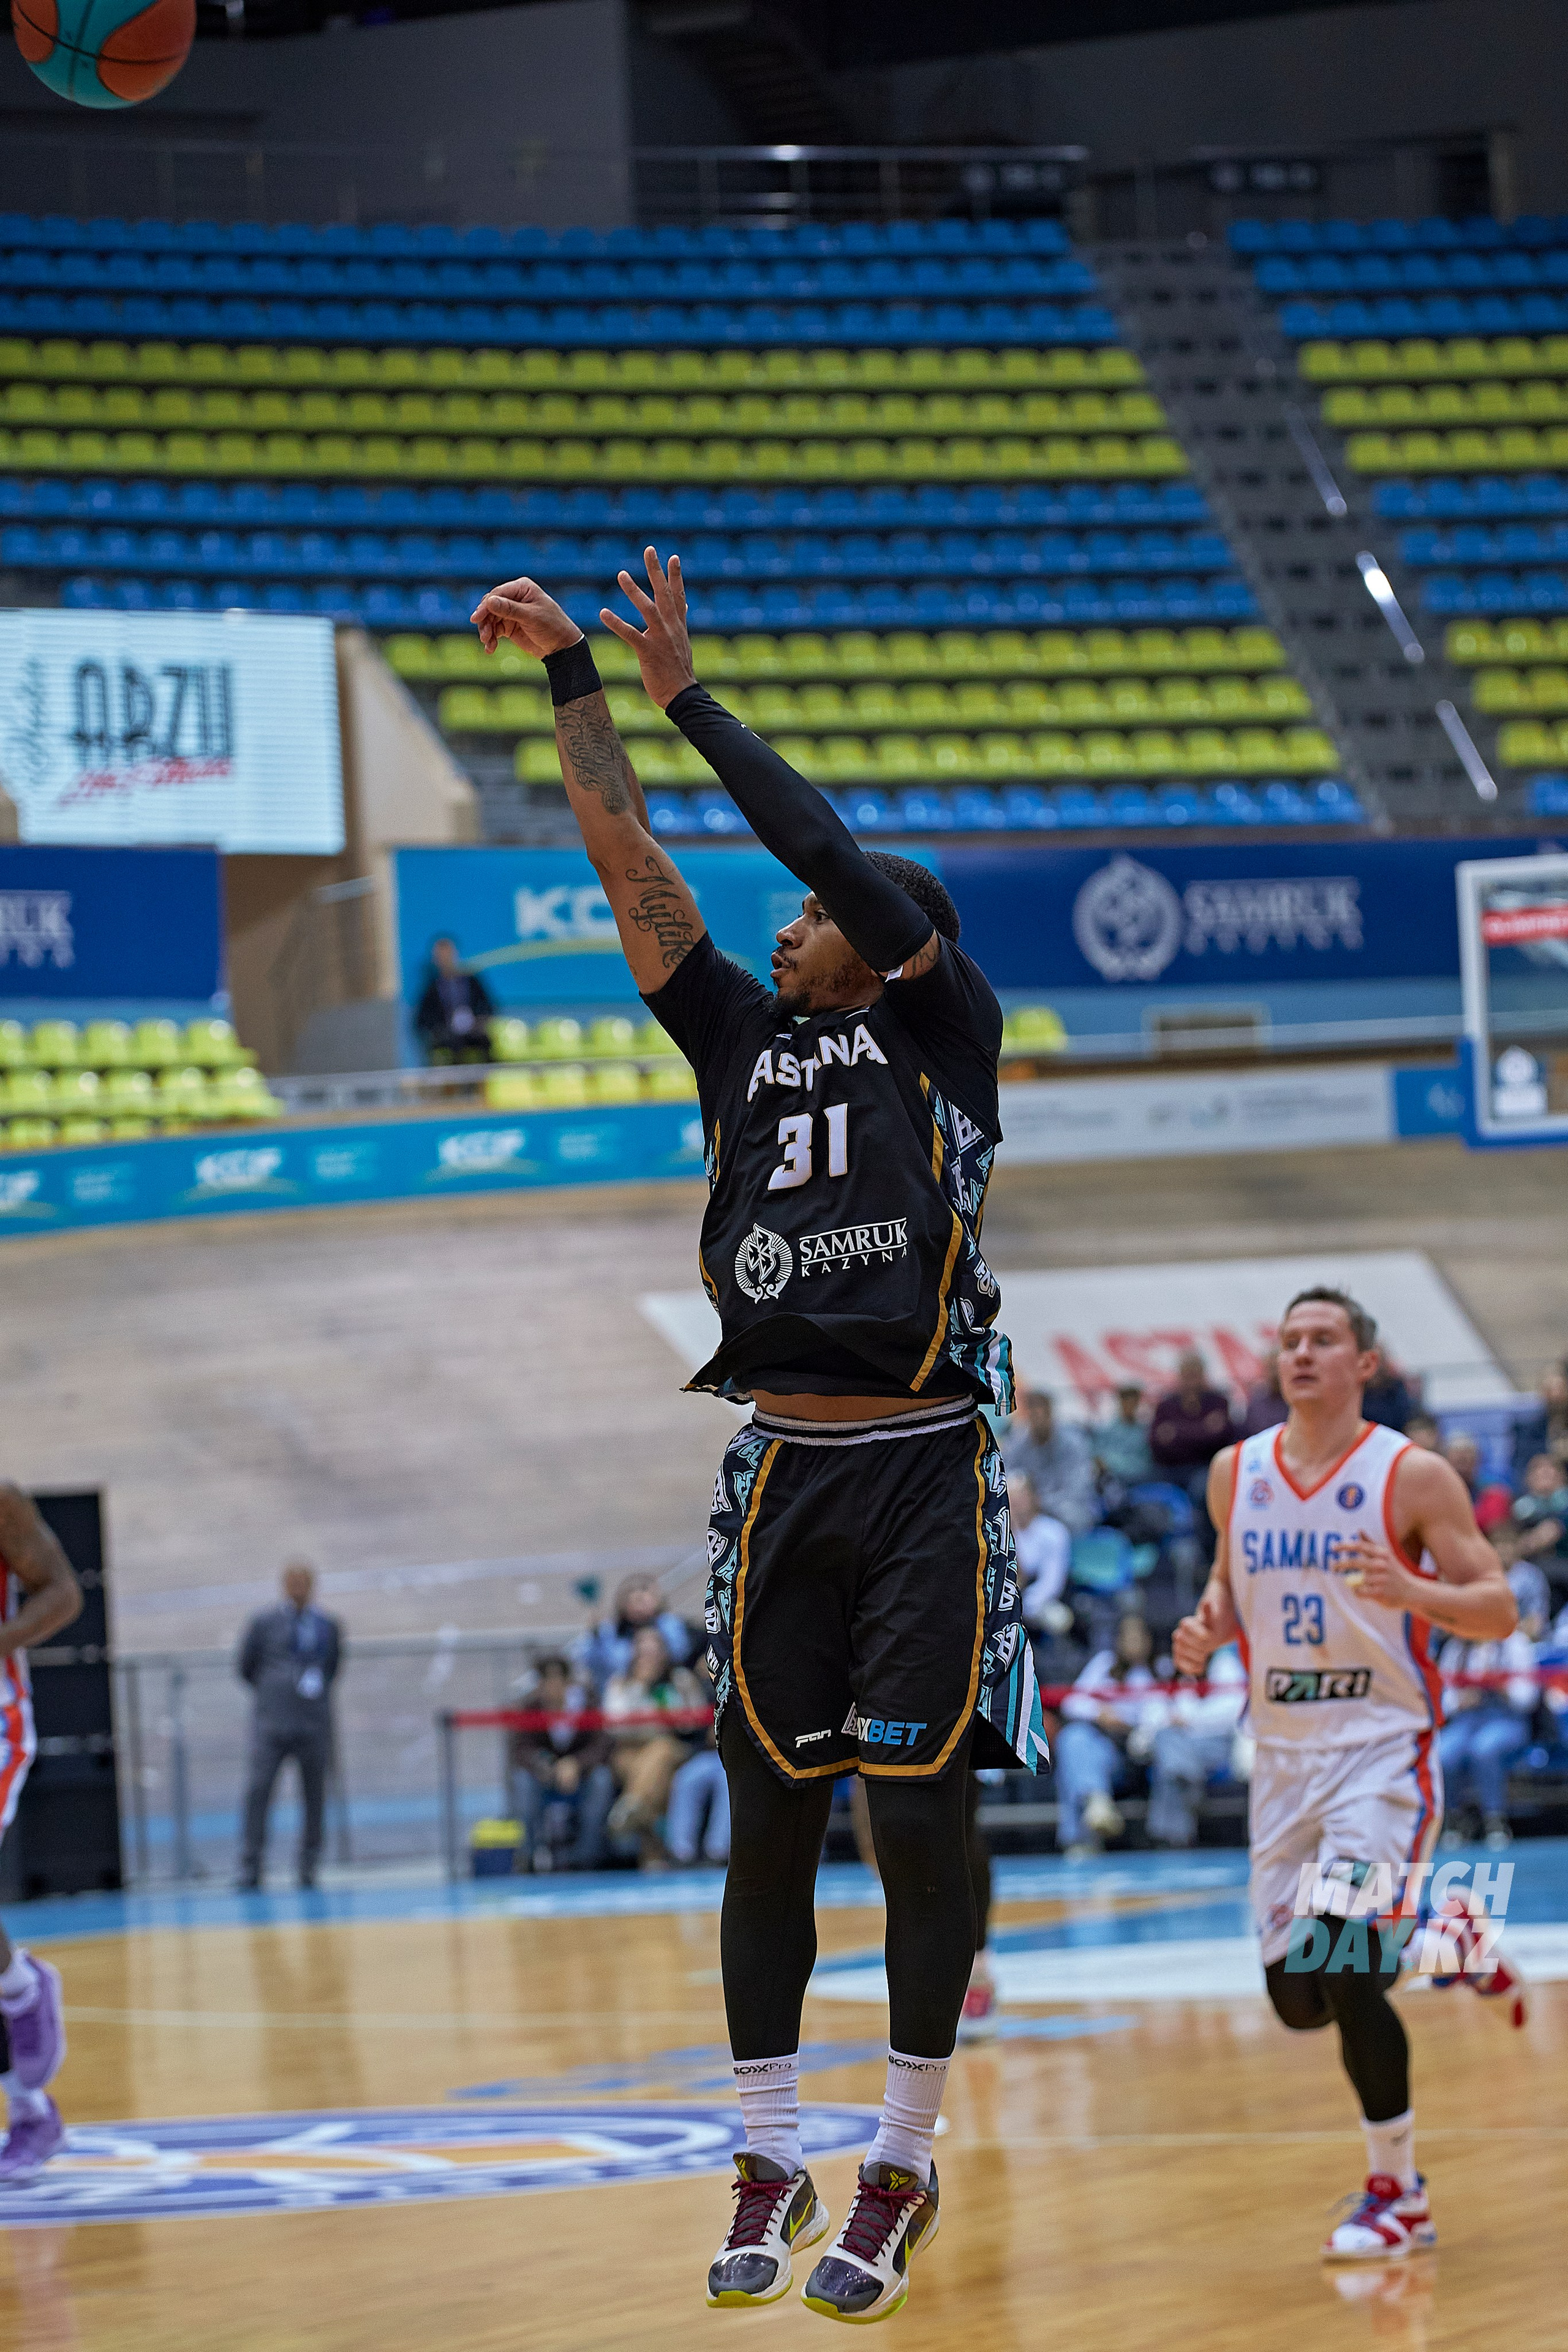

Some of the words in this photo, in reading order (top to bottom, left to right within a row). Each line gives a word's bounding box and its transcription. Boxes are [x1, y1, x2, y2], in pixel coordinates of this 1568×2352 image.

[747, 1023, 889, 1102] ASTNA
[767, 1102, 848, 1191] 31
[799, 1221, 908, 1262] SAMRUK
[801, 1246, 907, 1277] KAZYNA
[1283, 1593, 1325, 1646] 23
